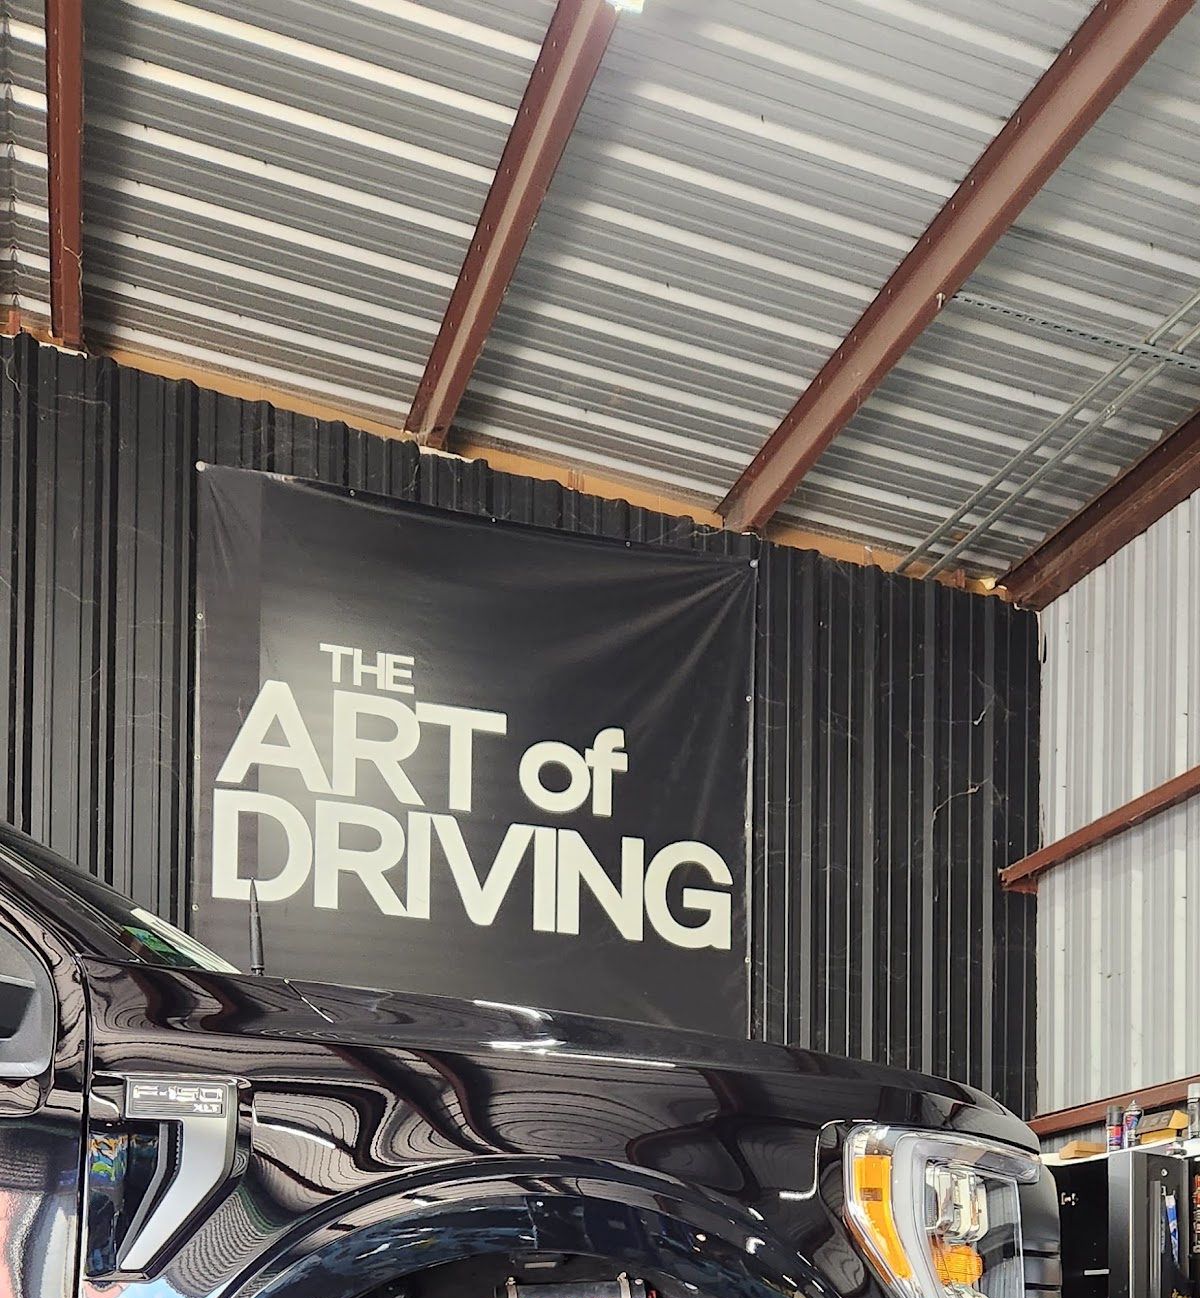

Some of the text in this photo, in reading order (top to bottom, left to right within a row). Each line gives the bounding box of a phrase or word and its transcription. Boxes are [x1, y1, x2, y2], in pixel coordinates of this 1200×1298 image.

[319, 643, 415, 694] THE
[216, 679, 629, 817] ART of
[211, 787, 734, 951] DRIVING
[133, 1085, 223, 1102] F-150
[193, 1103, 219, 1113] XLT
